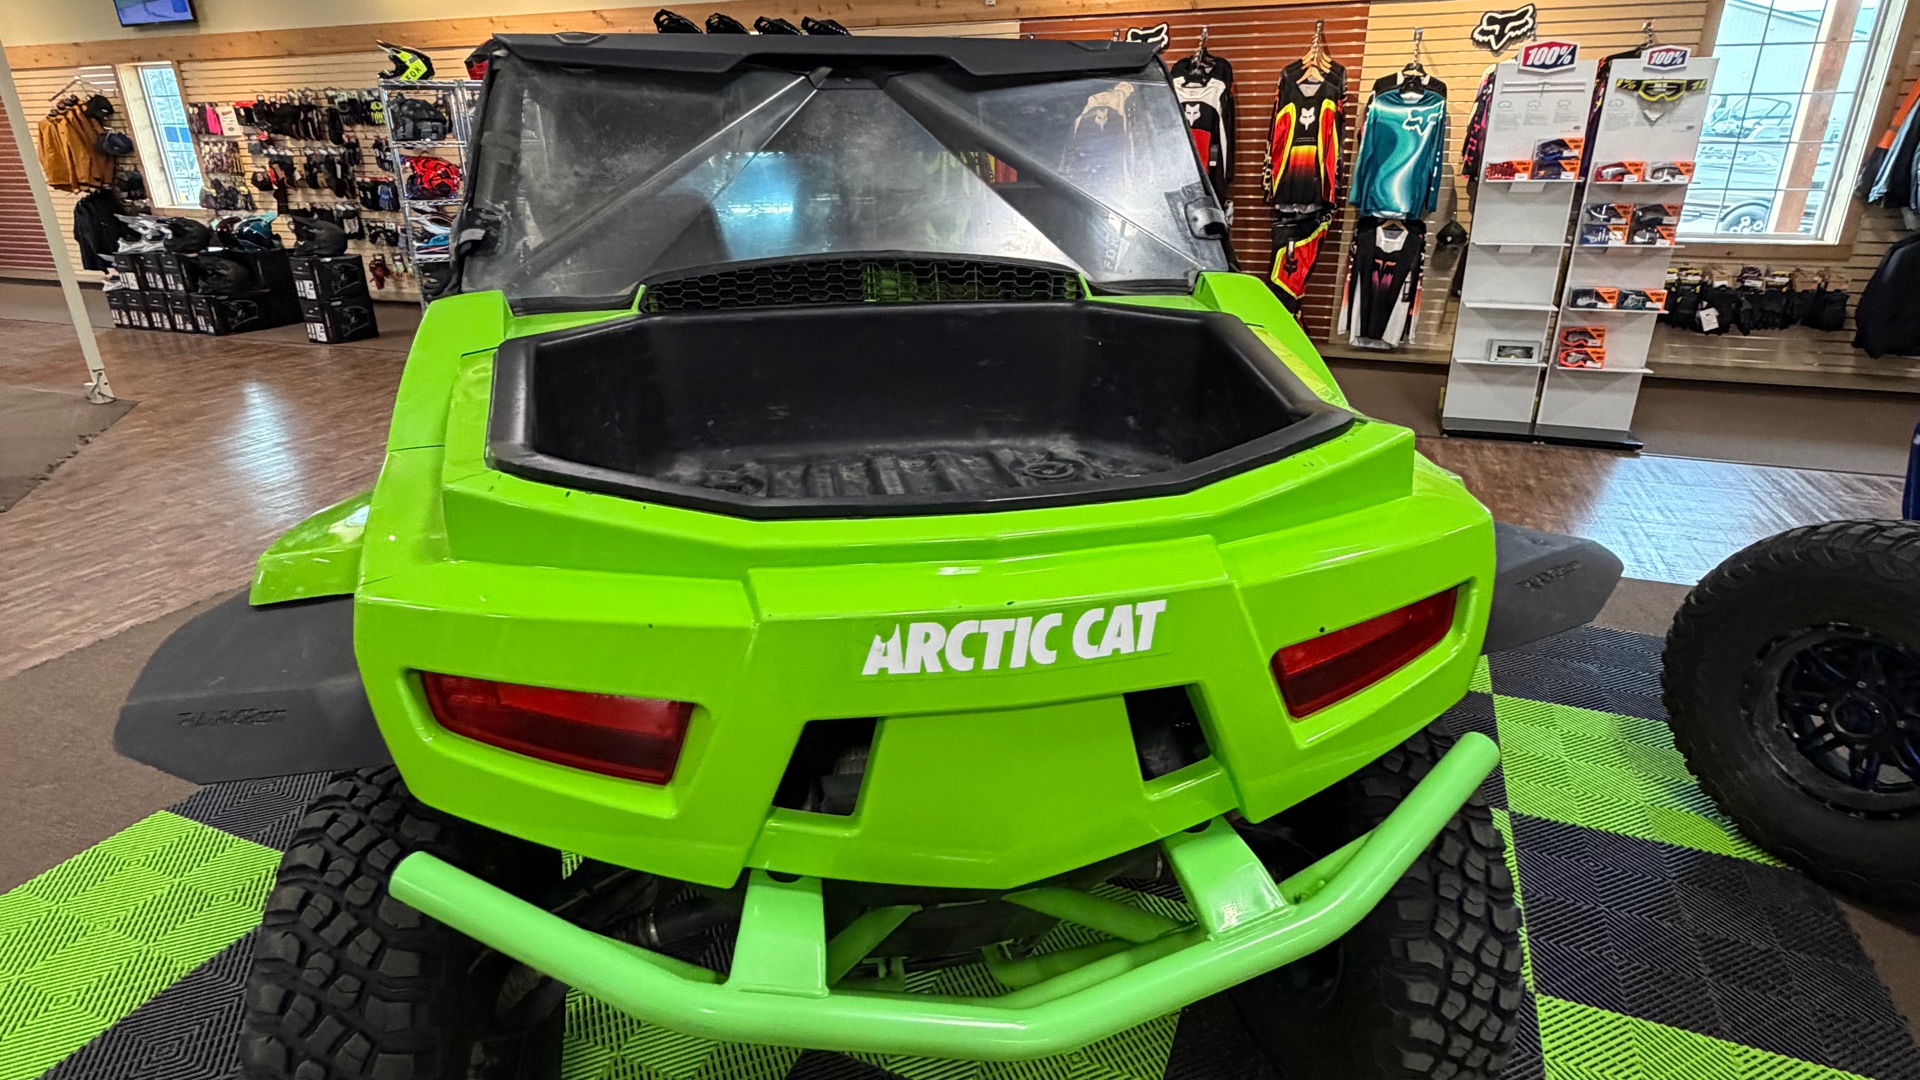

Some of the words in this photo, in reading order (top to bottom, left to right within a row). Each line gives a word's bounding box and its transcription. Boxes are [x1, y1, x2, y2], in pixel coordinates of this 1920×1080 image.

[1525, 45, 1572, 65] 100%
[1649, 50, 1684, 65] 100%
[404, 65, 422, 80] FOX
[861, 612, 1064, 676] ARCTIC
[1072, 599, 1167, 660] CAT
